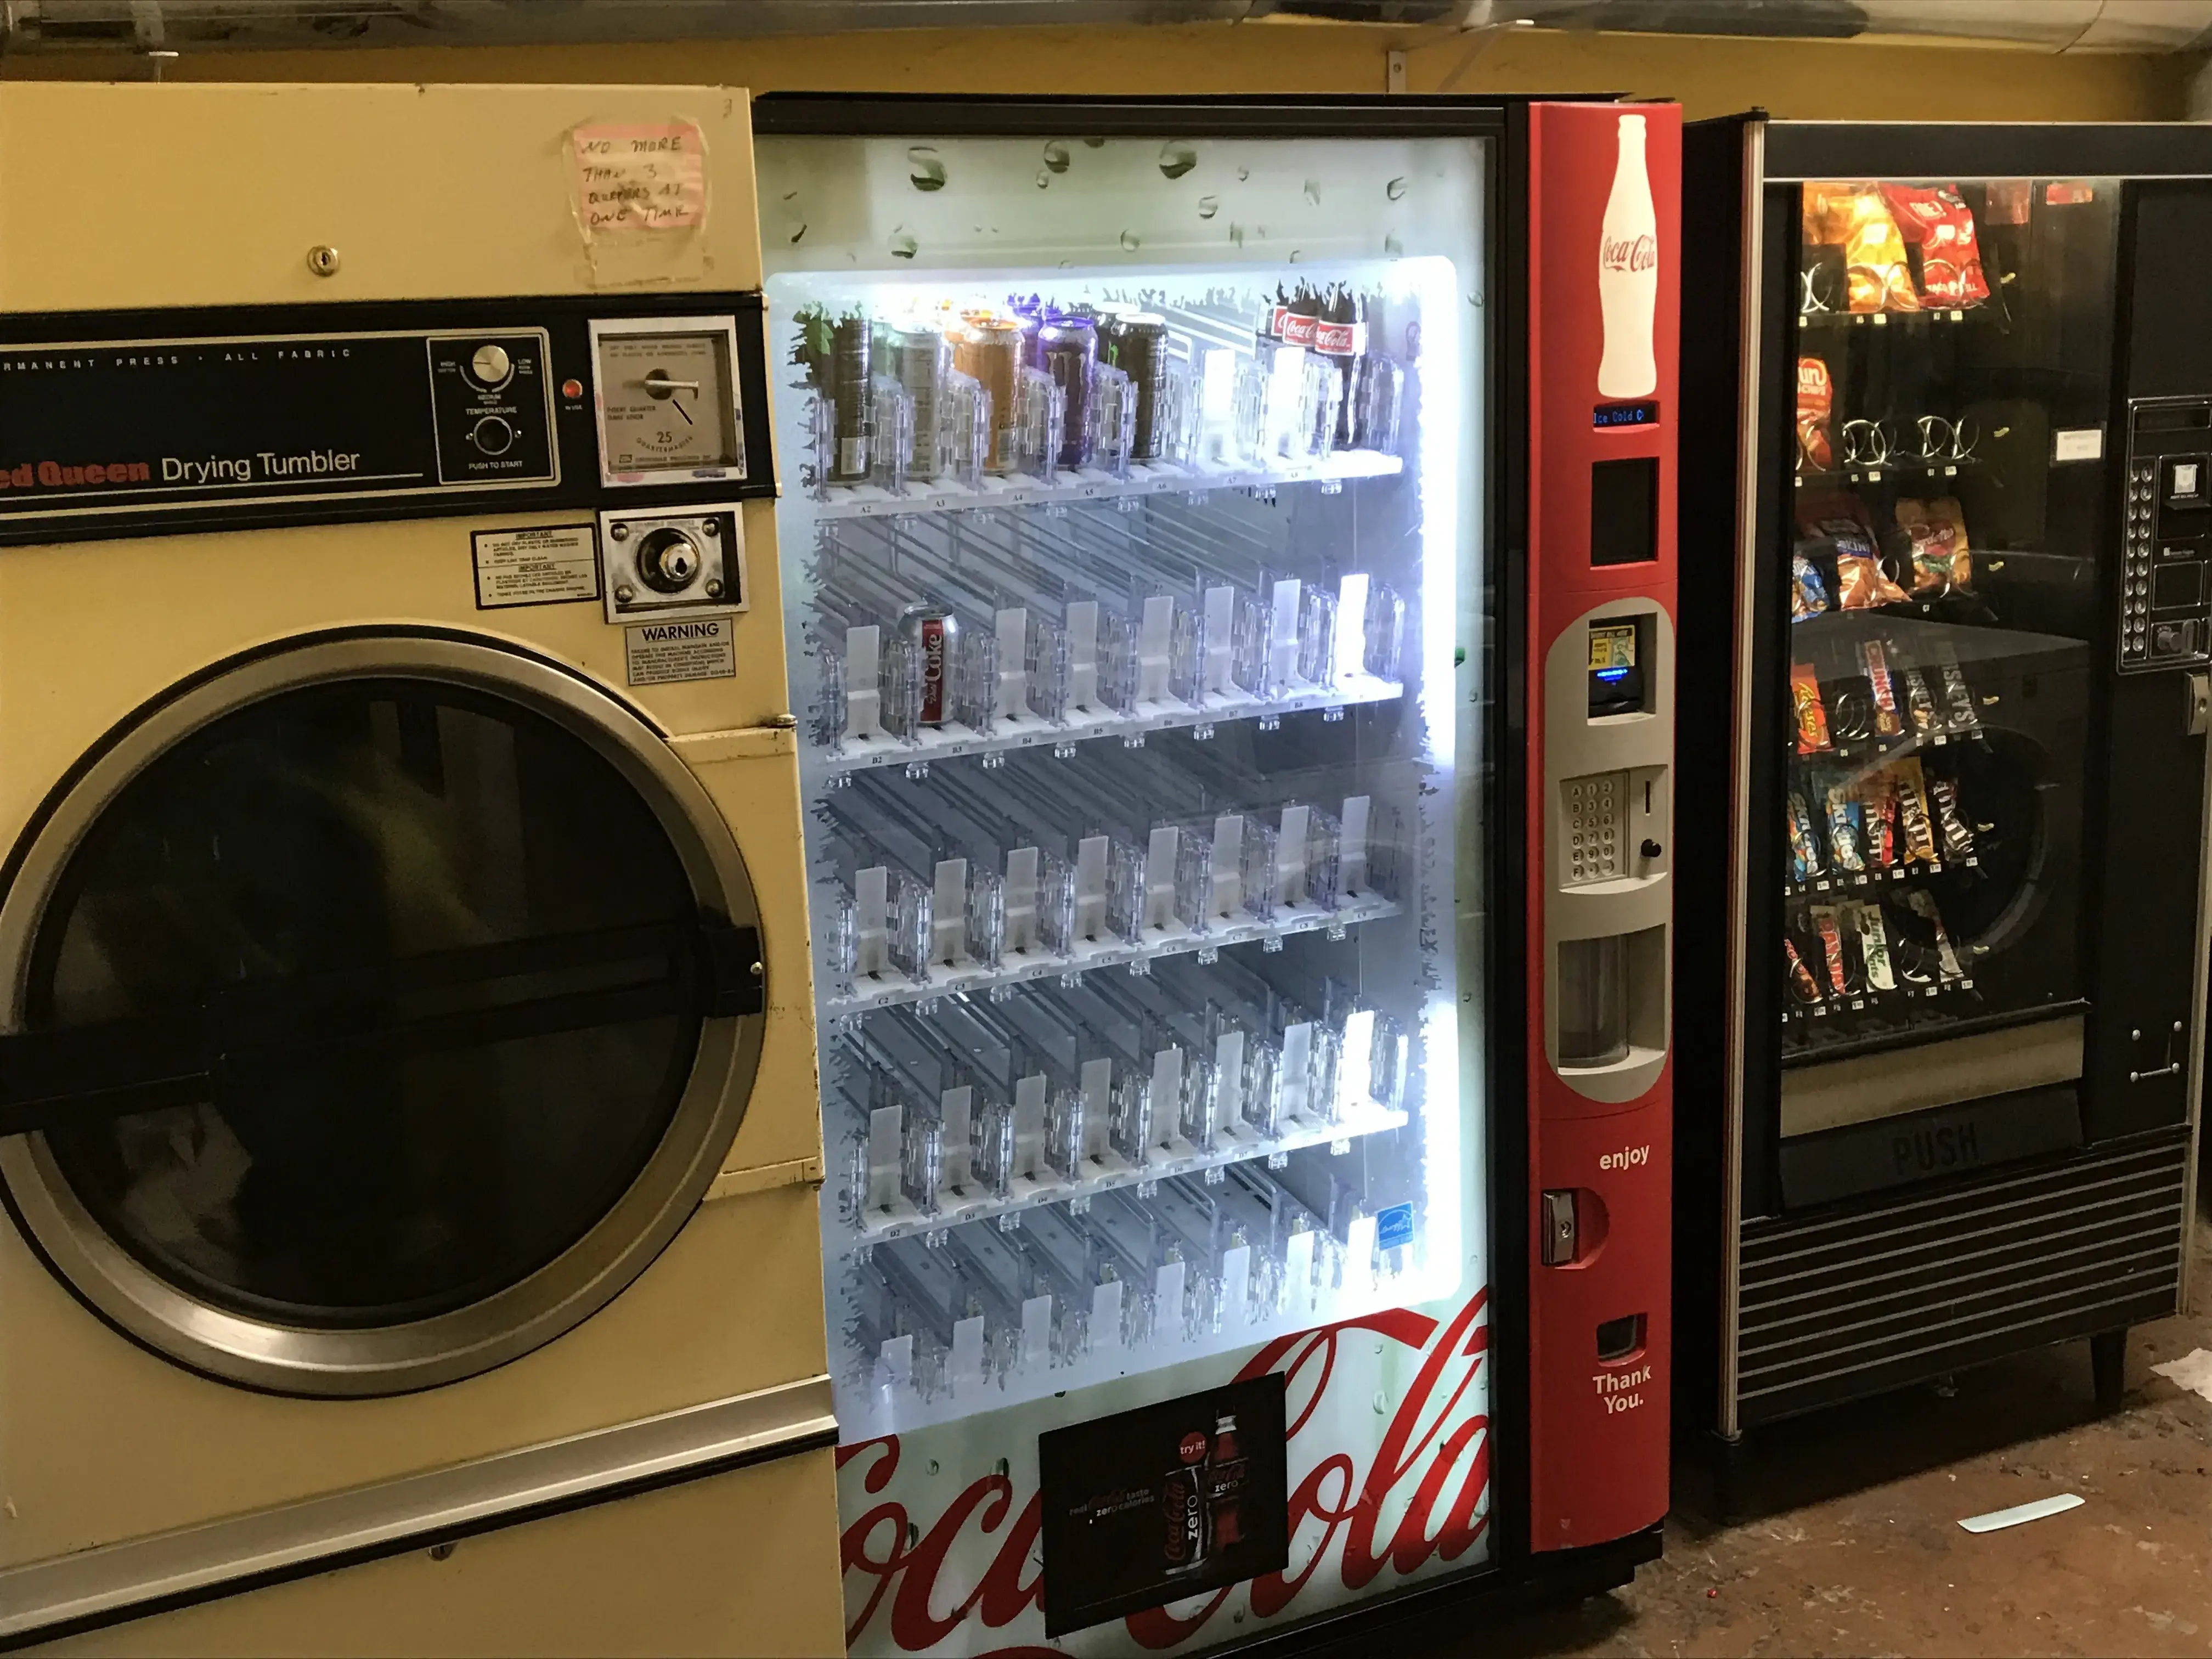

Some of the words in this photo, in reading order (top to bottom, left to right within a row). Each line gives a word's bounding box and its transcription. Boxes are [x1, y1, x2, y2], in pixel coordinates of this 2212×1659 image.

[582, 140, 611, 154] NO
[631, 136, 681, 152] MORE
[583, 167, 626, 182] THAN
[643, 164, 657, 178] 3
[1602, 234, 1655, 272] Coca-Cola
[116, 357, 178, 366] PRESS
[225, 353, 258, 361] ALL
[278, 349, 349, 358] FABRIC
[466, 407, 517, 415] TEMPERATURE
[1594, 413, 1607, 423] Ice
[1612, 410, 1633, 422] Cold
[656, 431, 673, 443] 25
[38, 461, 150, 486] Queen
[162, 455, 251, 483] Drying
[257, 449, 360, 476] Tumbler
[642, 623, 719, 641] WARNING
[1604, 783, 1609, 792] 2
[1573, 804, 1579, 812] B
[1589, 802, 1594, 810] 3
[1605, 799, 1610, 808] 4
[1573, 820, 1579, 828] C
[1589, 818, 1594, 827] 5
[1604, 816, 1609, 825] 6
[1573, 836, 1579, 845] D
[1589, 834, 1594, 842] 7
[1604, 832, 1609, 840] 8
[1573, 852, 1579, 861] E
[1589, 850, 1594, 859] 9
[1573, 868, 1578, 877] F
[1893, 1122, 1980, 1175] PUSH
[1600, 1146, 1650, 1170] enjoy
[1593, 1366, 1652, 1395] Thank
[1604, 1393, 1644, 1414] You.
[1180, 1442, 1195, 1455] try
[1195, 1440, 1205, 1450] it!
[1215, 1480, 1238, 1492] zero
[1126, 1489, 1150, 1502] taste
[1097, 1506, 1117, 1517] zero
[1119, 1494, 1154, 1510] calories
[1187, 1495, 1198, 1540] zero
